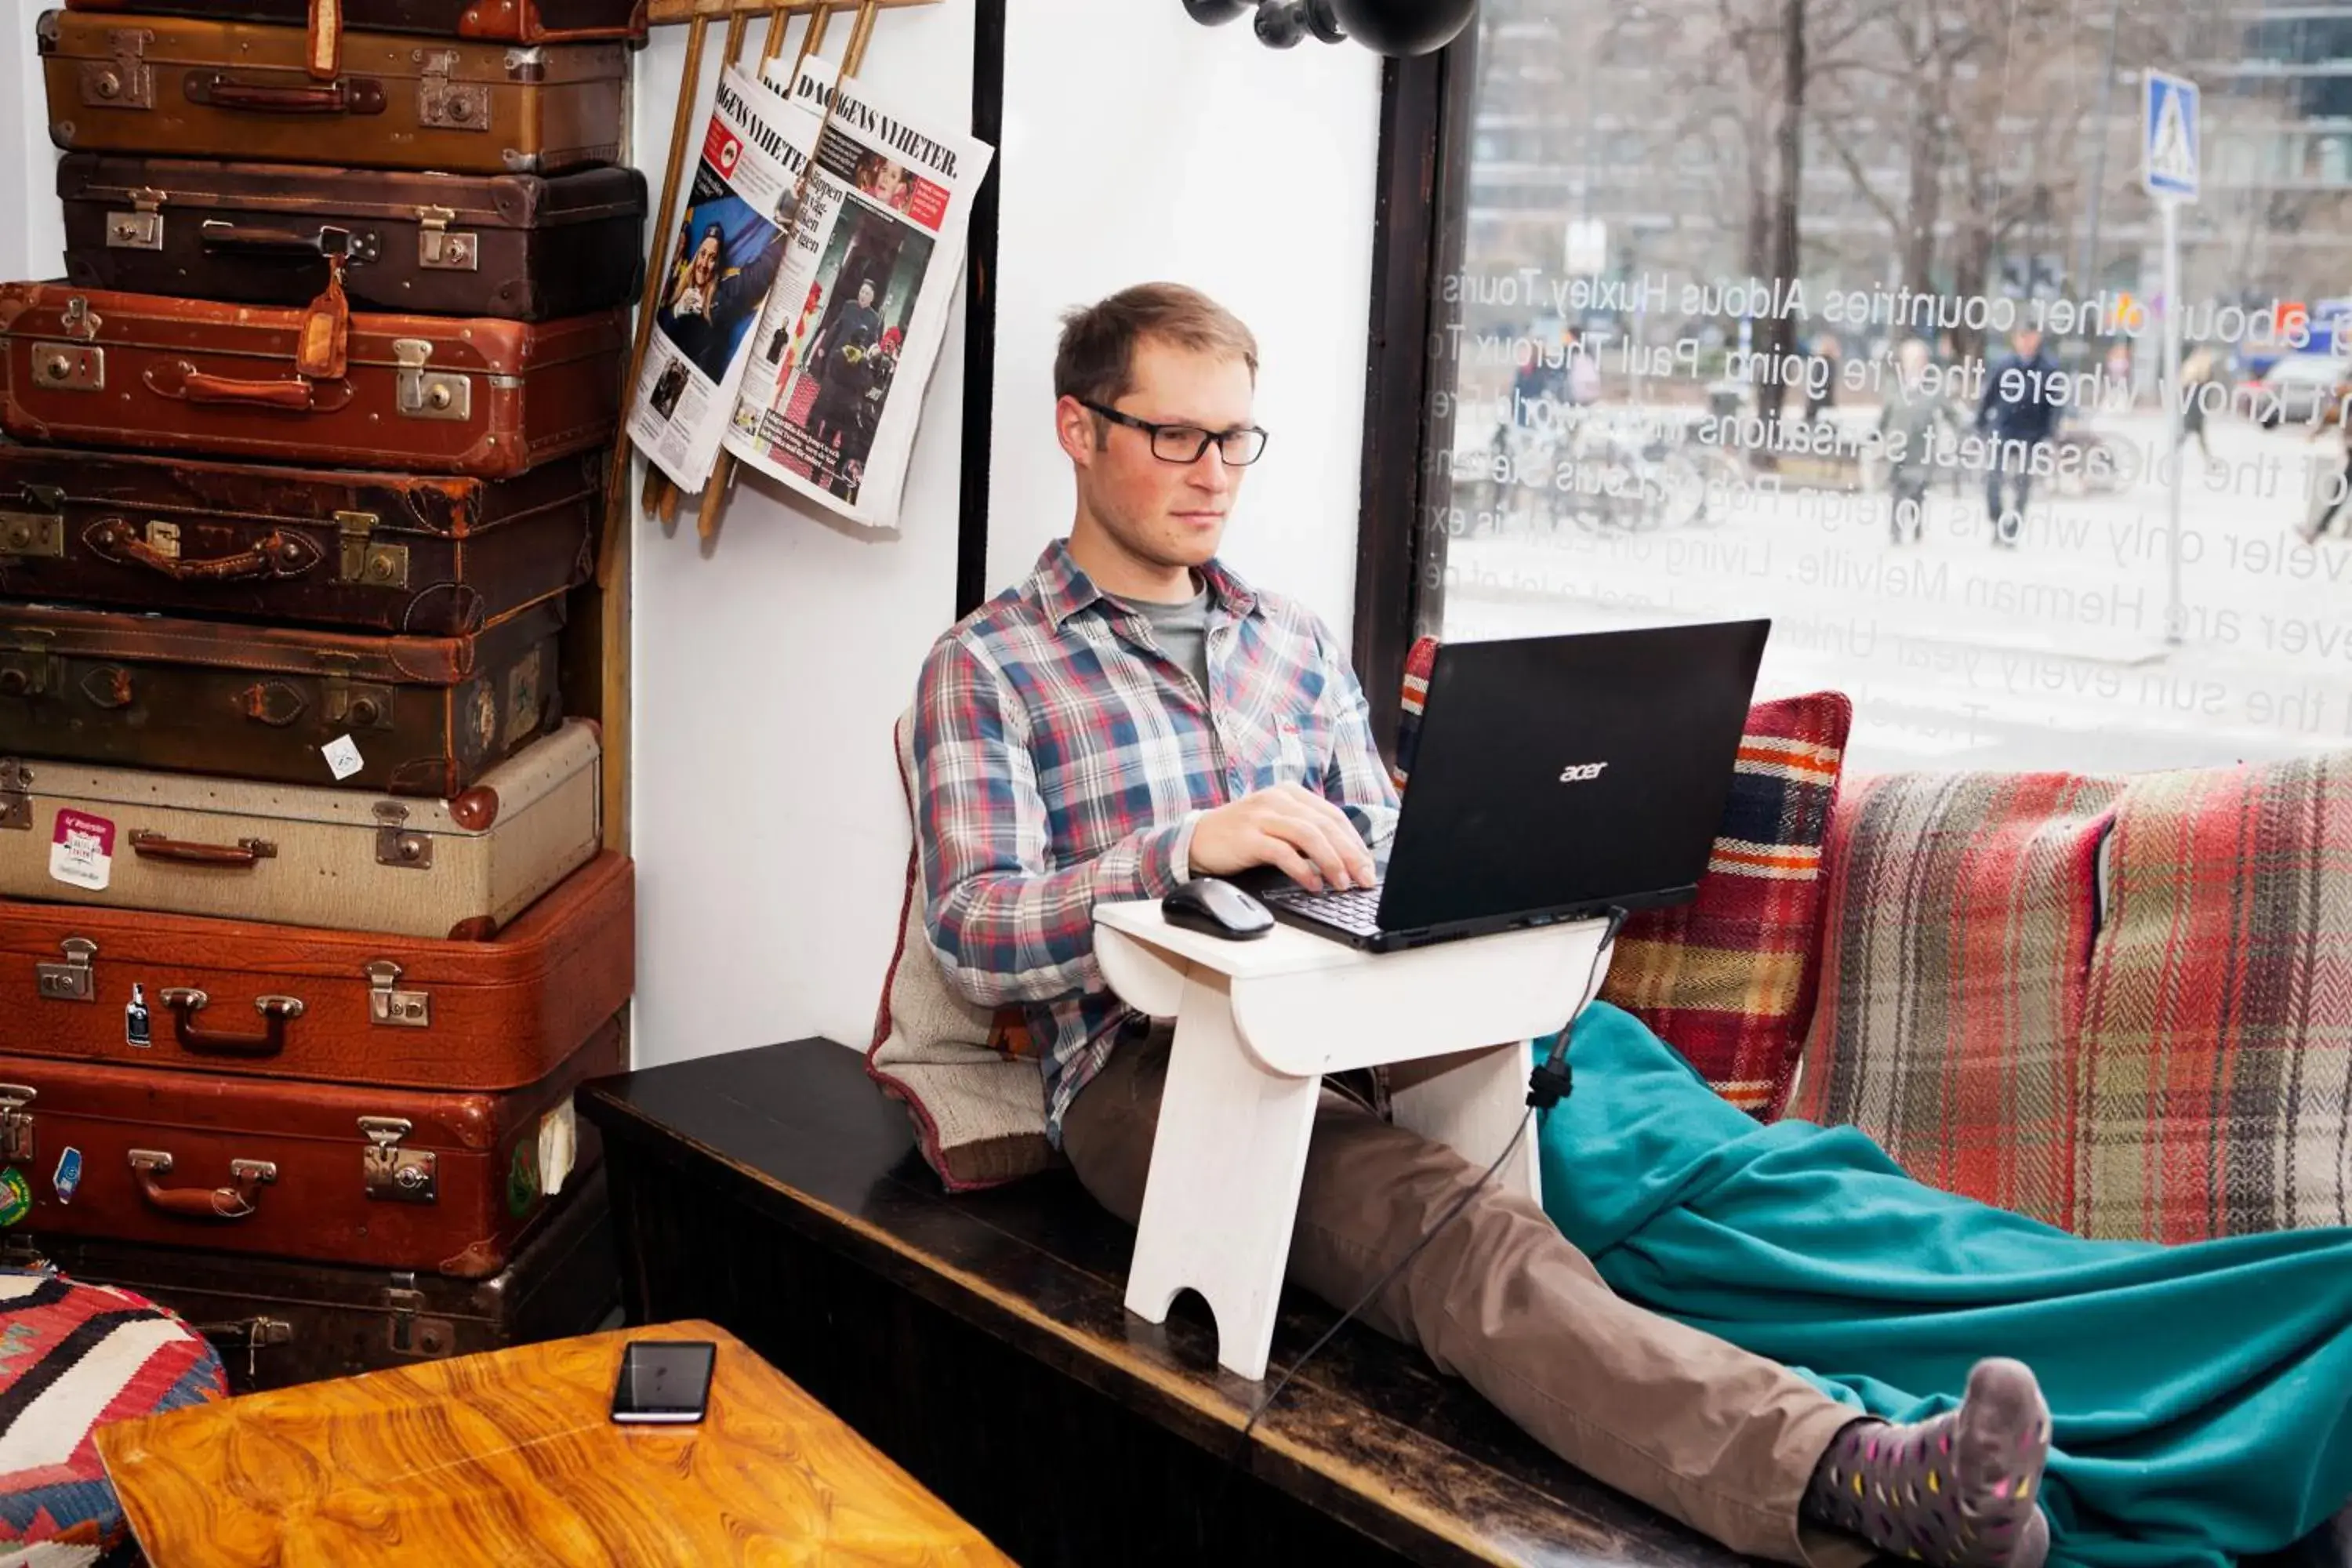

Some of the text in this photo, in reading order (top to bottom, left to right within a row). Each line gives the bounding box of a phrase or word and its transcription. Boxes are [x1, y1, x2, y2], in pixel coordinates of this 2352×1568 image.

[748, 113, 808, 176] NYHETE
[879, 114, 958, 180] NYHETER.
[1559, 761, 1609, 782] acer
